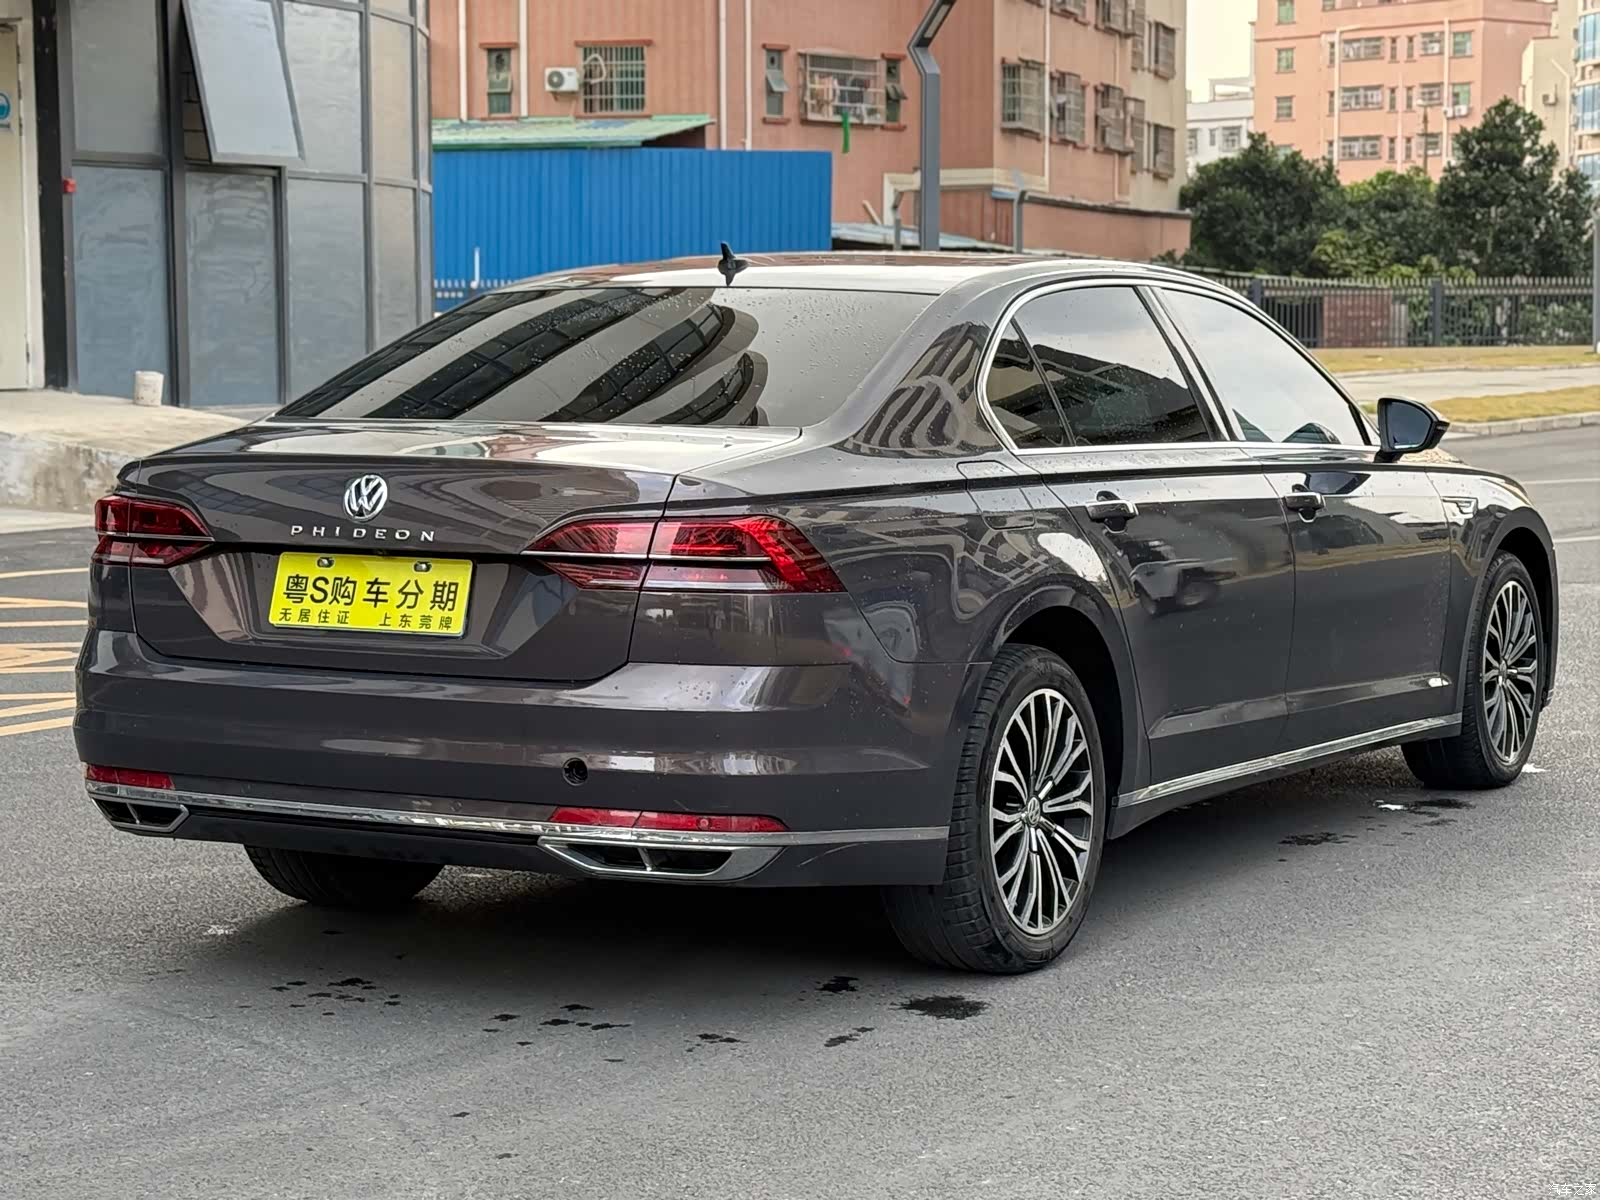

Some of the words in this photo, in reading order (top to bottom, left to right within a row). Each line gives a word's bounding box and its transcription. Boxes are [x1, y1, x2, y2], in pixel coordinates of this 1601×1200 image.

[290, 525, 436, 542] PHIDEON
[282, 573, 460, 612] 粤S购车分期
[278, 607, 351, 625] 无居住证
[378, 612, 453, 631] 上东莞牌
